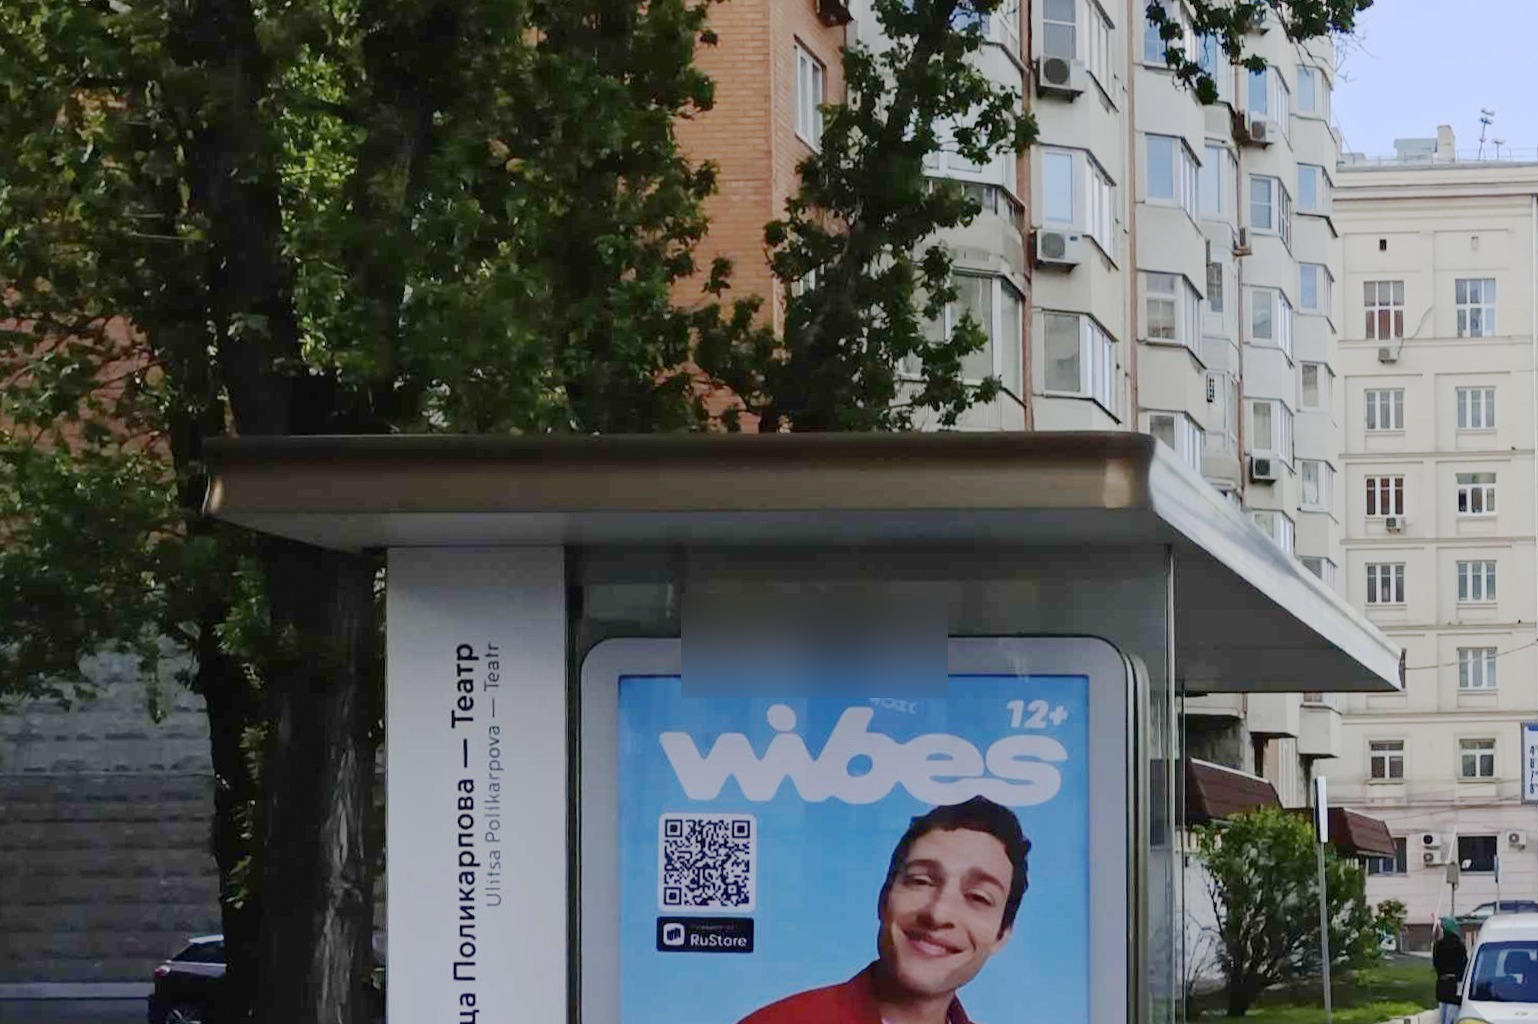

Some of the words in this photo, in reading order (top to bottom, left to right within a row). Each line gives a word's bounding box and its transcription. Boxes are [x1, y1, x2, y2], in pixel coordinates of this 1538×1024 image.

[451, 643, 479, 729] Театр
[484, 643, 500, 693] Teatr
[1007, 699, 1069, 729] 12+
[485, 725, 504, 843] Polikarpova
[658, 703, 1069, 807] wibes
[453, 779, 480, 981] Поликарпова
[485, 850, 501, 907] Ulitsa
[690, 933, 748, 948] RuStore
